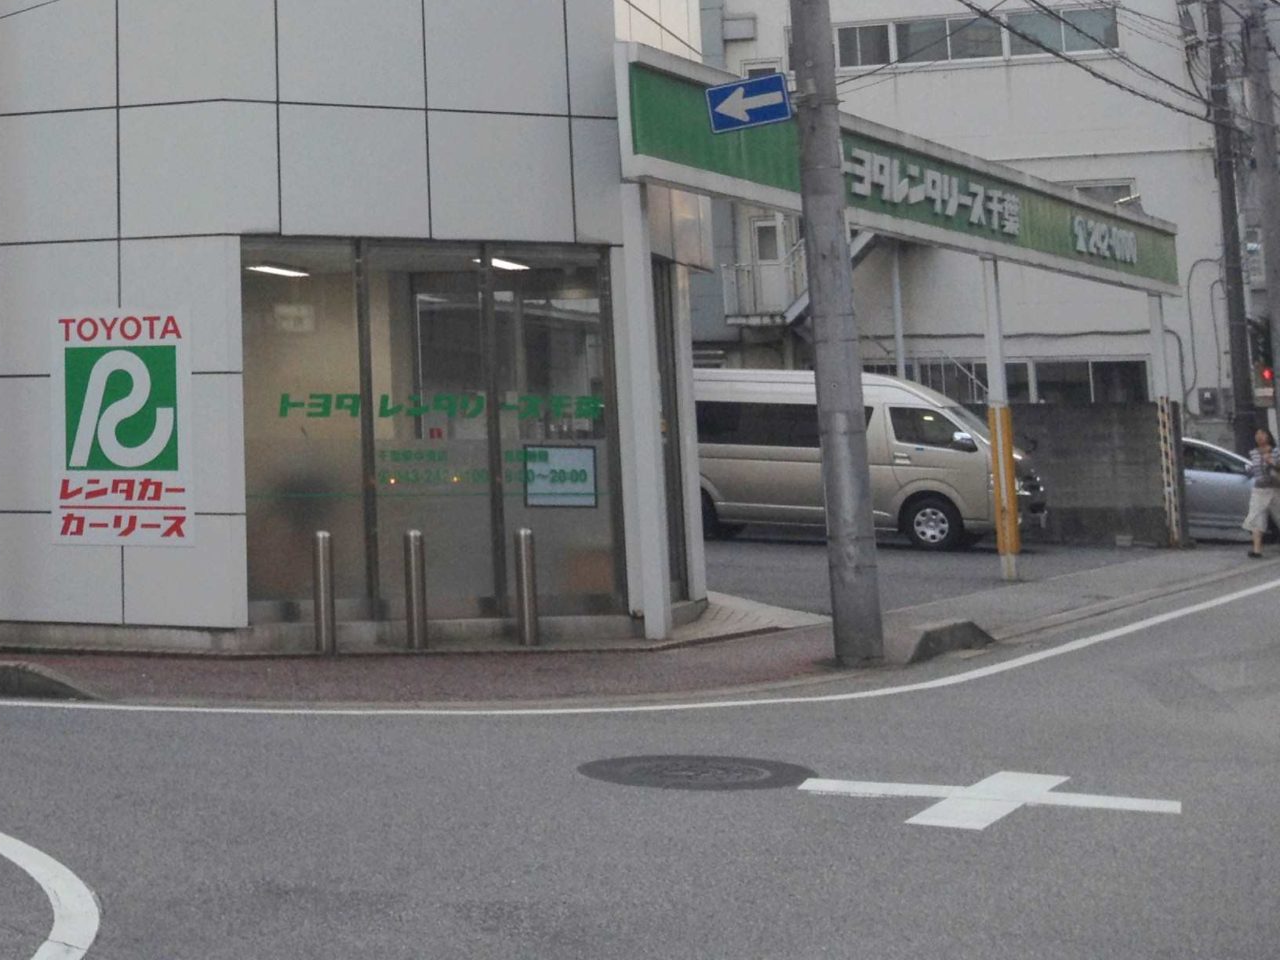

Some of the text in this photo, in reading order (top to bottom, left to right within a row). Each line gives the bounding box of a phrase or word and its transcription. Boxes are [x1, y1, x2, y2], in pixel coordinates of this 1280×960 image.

[58, 315, 182, 341] TOYOTA
[59, 478, 186, 501] レンタカー
[60, 513, 187, 538] カーリース
